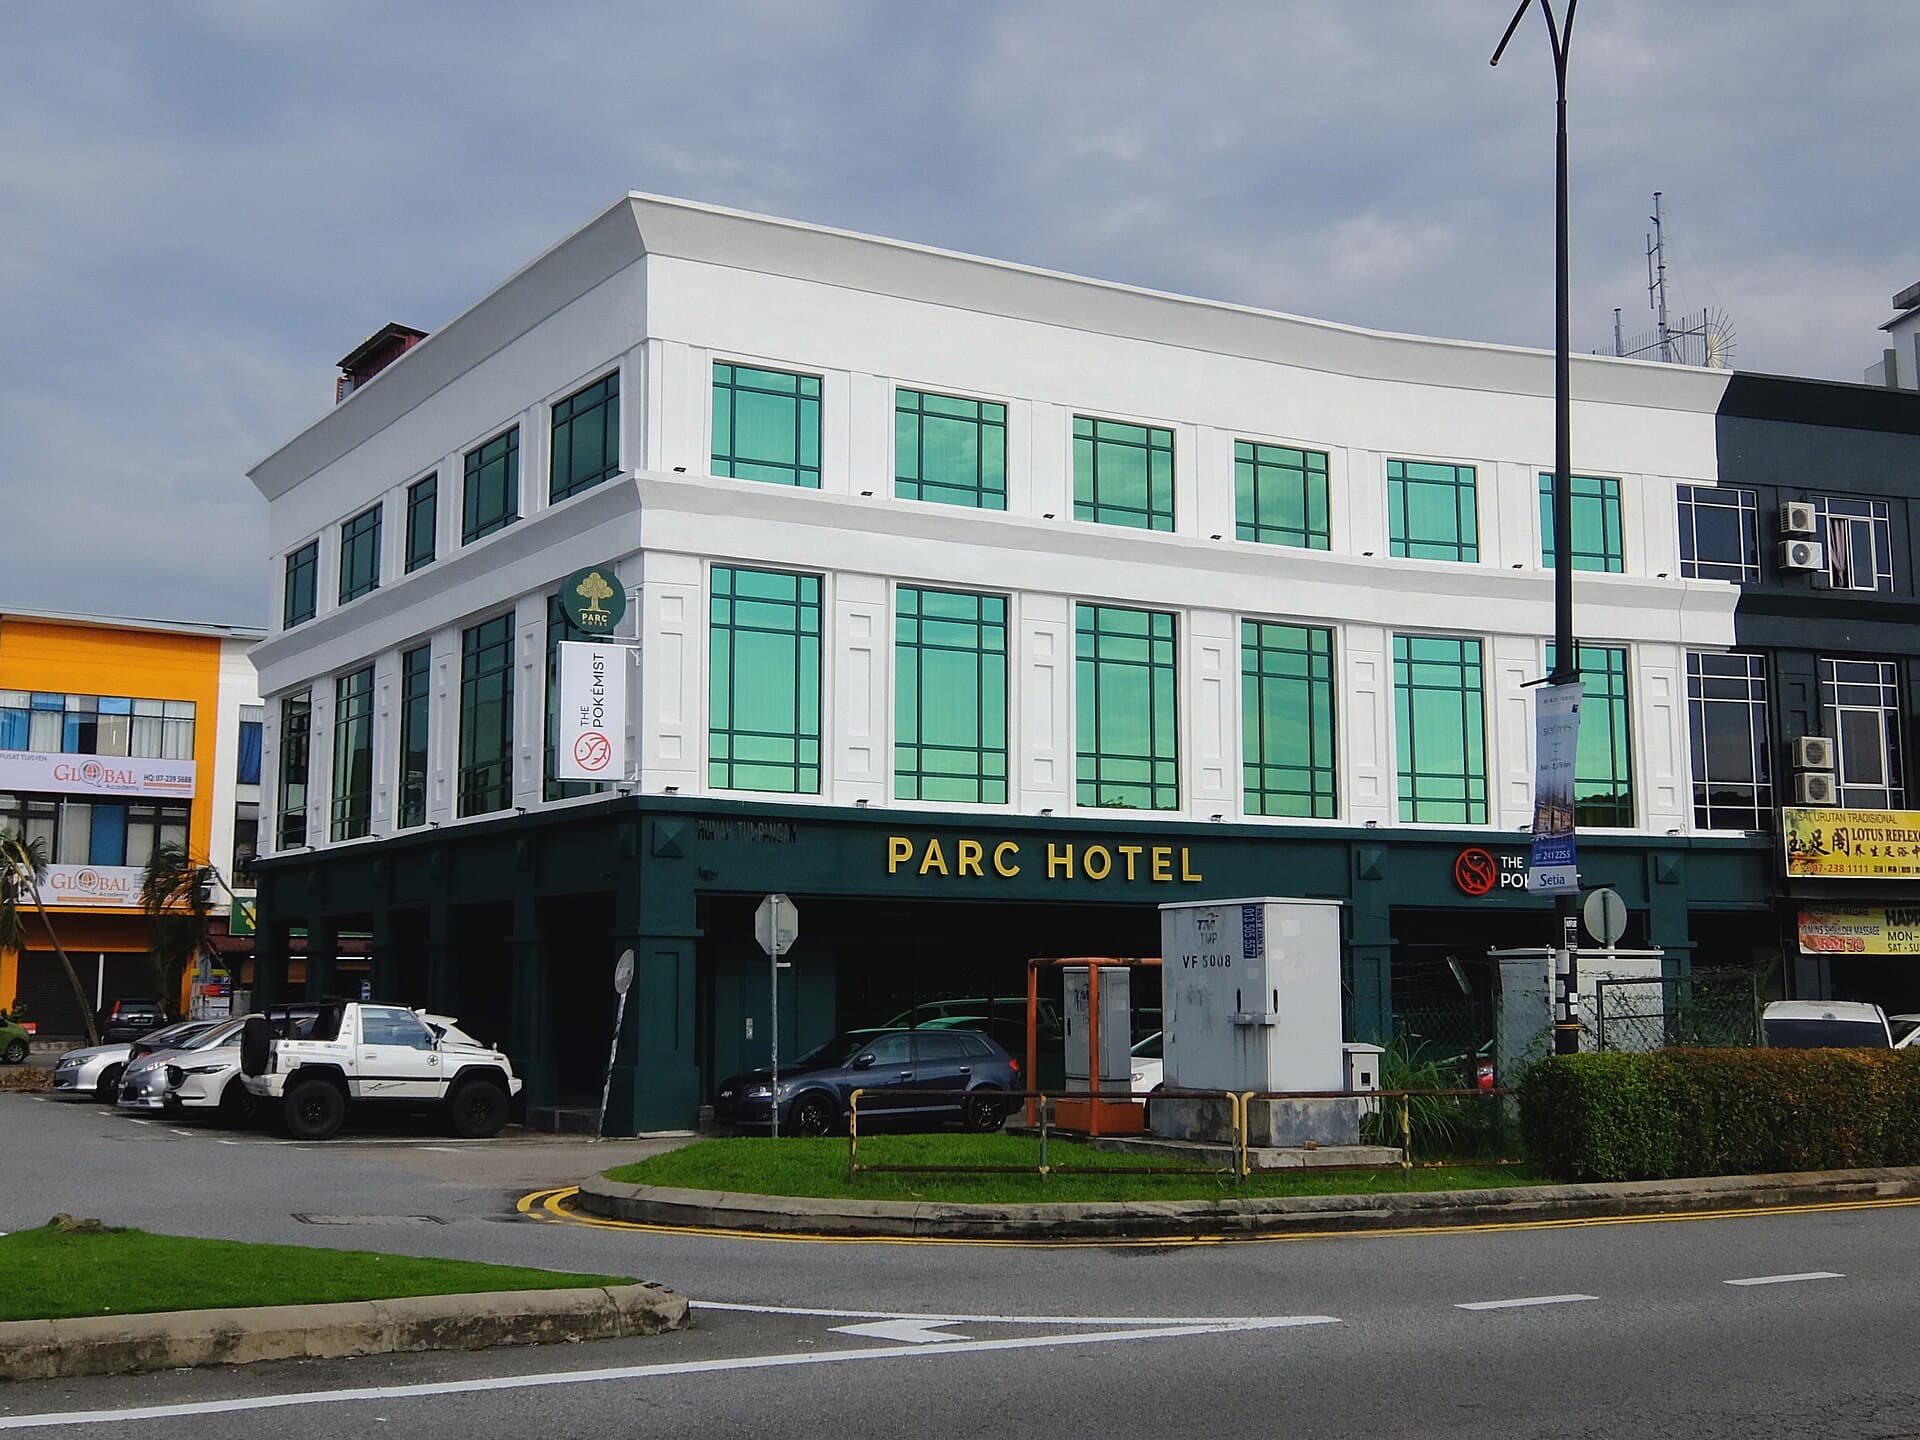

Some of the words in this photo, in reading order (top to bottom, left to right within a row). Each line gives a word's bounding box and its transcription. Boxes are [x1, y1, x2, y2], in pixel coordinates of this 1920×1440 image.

[582, 613, 607, 622] PARC
[590, 652, 604, 728] POKÉMIST
[580, 705, 589, 727] THE
[54, 760, 137, 786] GLOBAL
[106, 783, 140, 791] Academy
[1786, 810, 1813, 822] PUSAT
[1814, 812, 1846, 823] URUTAN
[1848, 812, 1898, 825] TRADISIONAL
[1851, 828, 1884, 841] LOTUS
[888, 836, 1021, 878] PARC
[1047, 843, 1203, 882] HOTEL
[1500, 856, 1524, 869] THE
[51, 868, 130, 893] GLOBAL
[1539, 873, 1566, 887] Setia
[1887, 943, 1902, 953] SAT
[1182, 955, 1198, 968] VF
[1202, 954, 1231, 968] 5008
